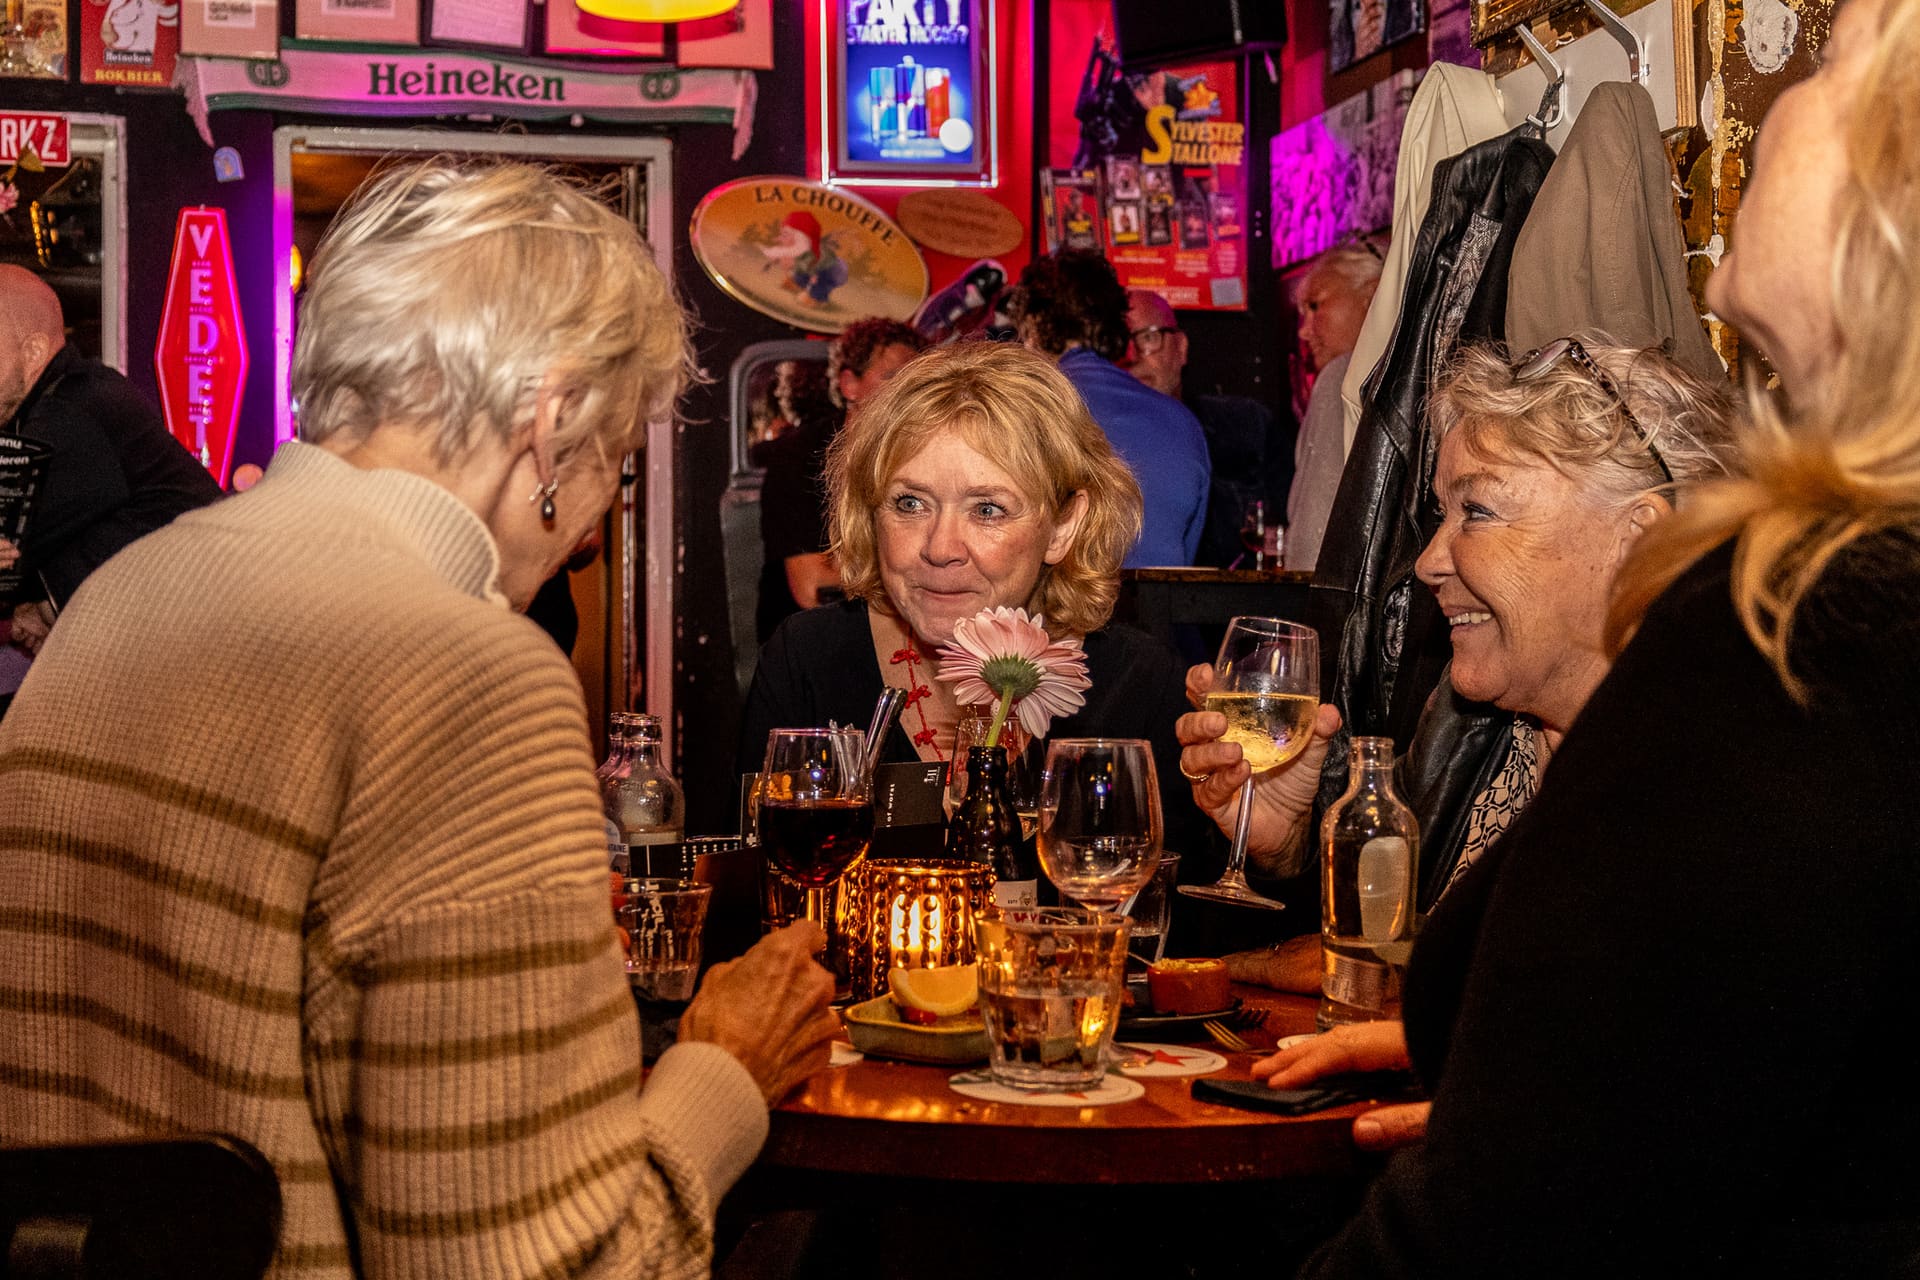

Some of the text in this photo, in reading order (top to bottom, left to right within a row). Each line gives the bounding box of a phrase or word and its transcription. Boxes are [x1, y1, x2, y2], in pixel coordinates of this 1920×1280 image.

[104, 50, 152, 65] Heineken
[95, 68, 163, 82] BOKBIER
[368, 63, 565, 101] Heineken
[755, 186, 784, 203] LA
[791, 187, 895, 246] CHOUFFE
